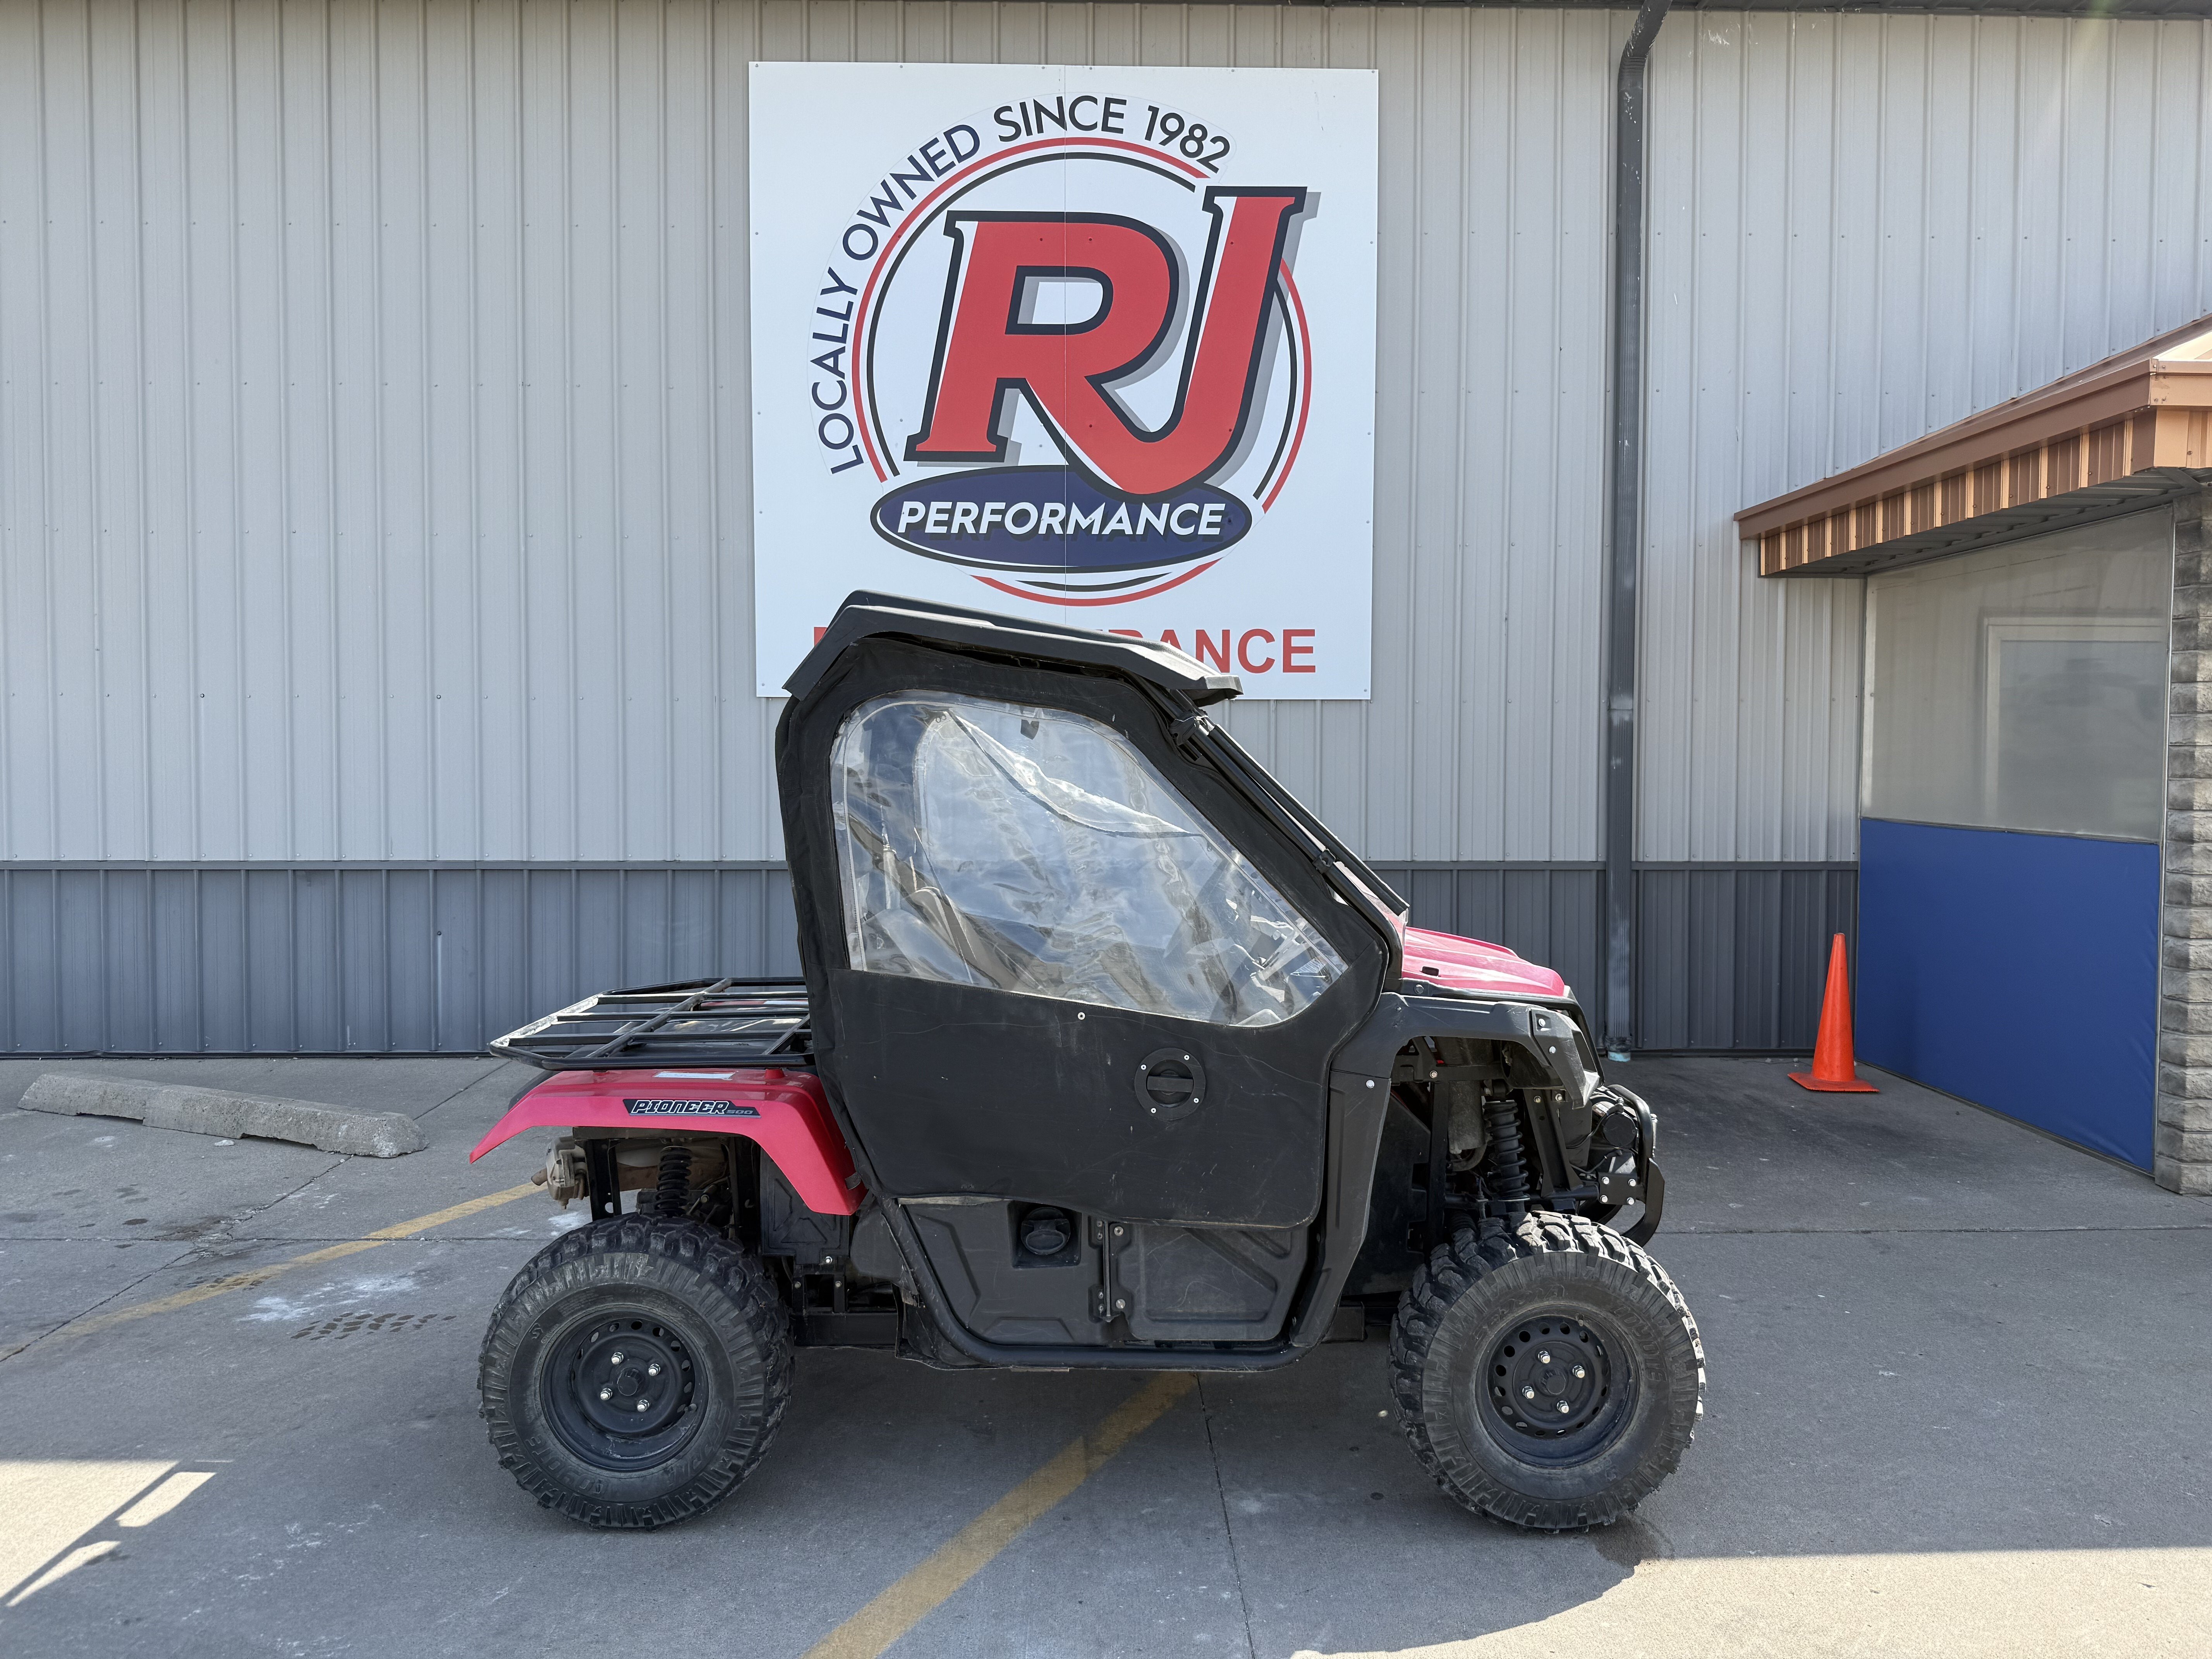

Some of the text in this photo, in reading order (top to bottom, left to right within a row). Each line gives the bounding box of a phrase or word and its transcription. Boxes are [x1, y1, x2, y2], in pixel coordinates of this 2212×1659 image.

[810, 95, 1230, 474] LOCALLY OWNED SINCE 1982
[903, 186, 1308, 504] RJ
[898, 501, 1225, 535] PERFORMANCE
[631, 1100, 730, 1114] PIONEER
